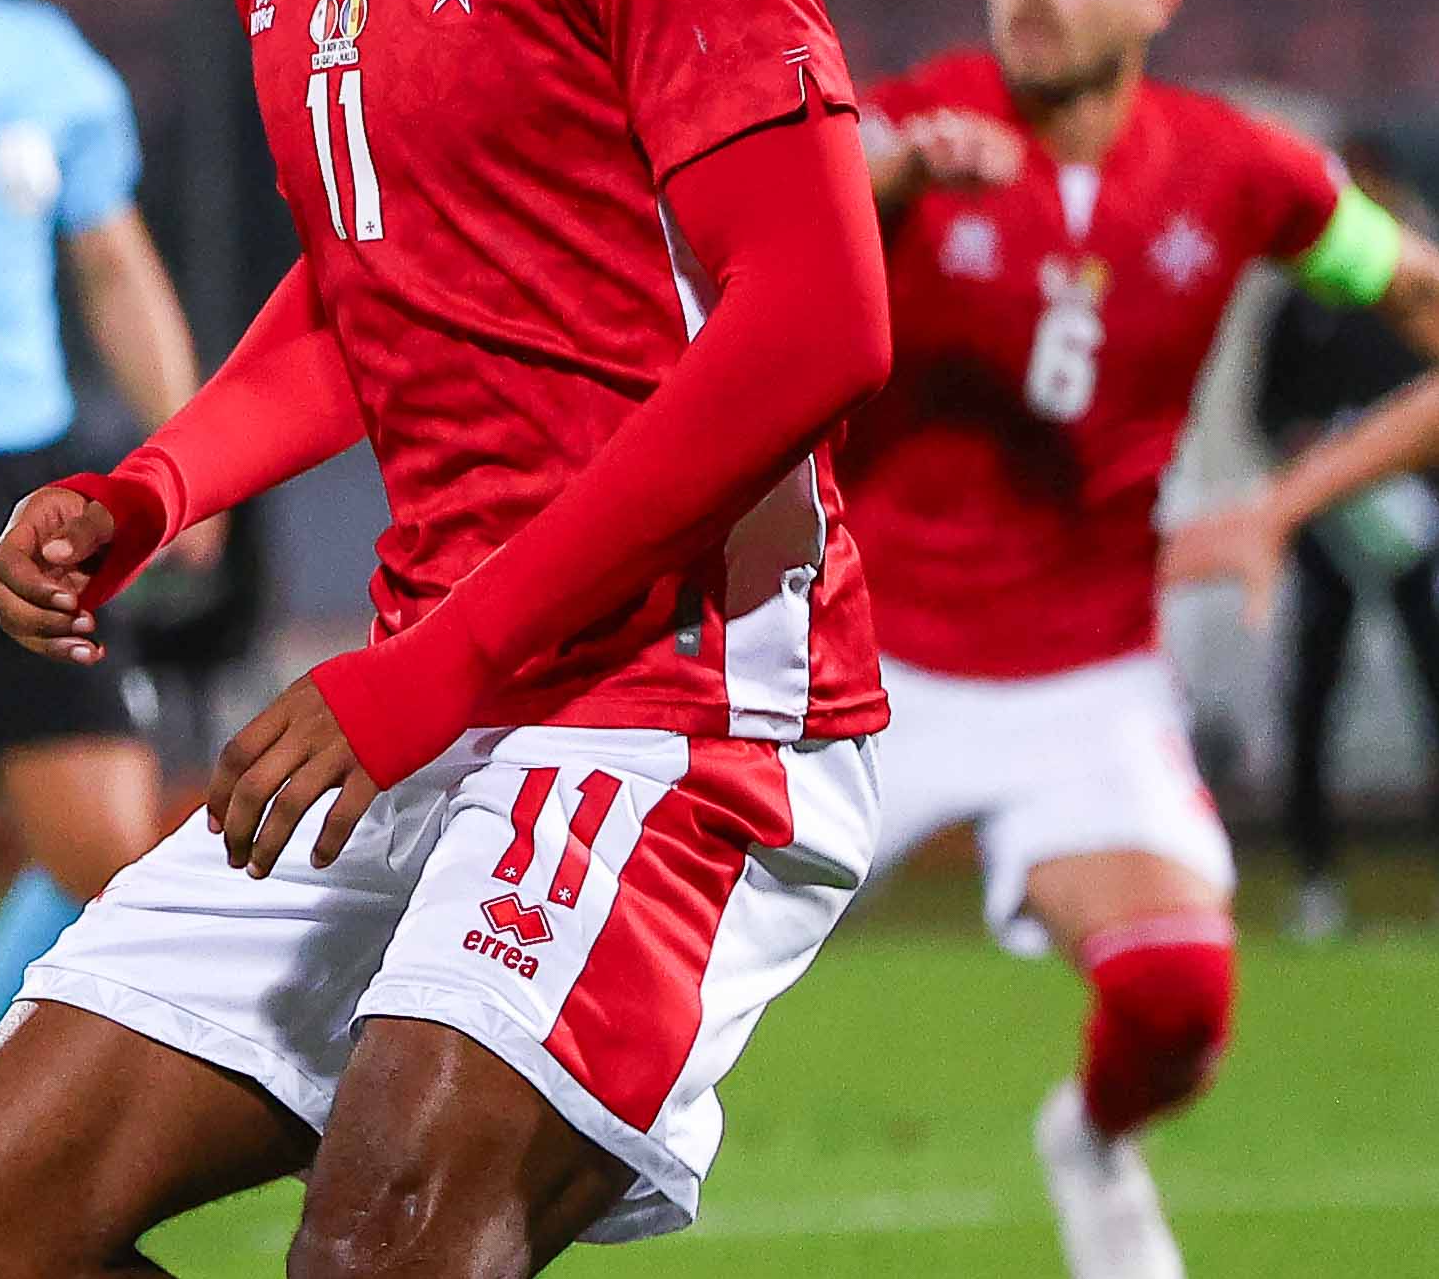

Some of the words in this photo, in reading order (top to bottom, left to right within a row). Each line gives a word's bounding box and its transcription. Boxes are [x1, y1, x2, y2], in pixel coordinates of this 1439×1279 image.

[306, 70, 383, 241] 11
[1026, 307, 1106, 420] 6
[491, 766, 623, 910] 11
[462, 929, 540, 981] errea
